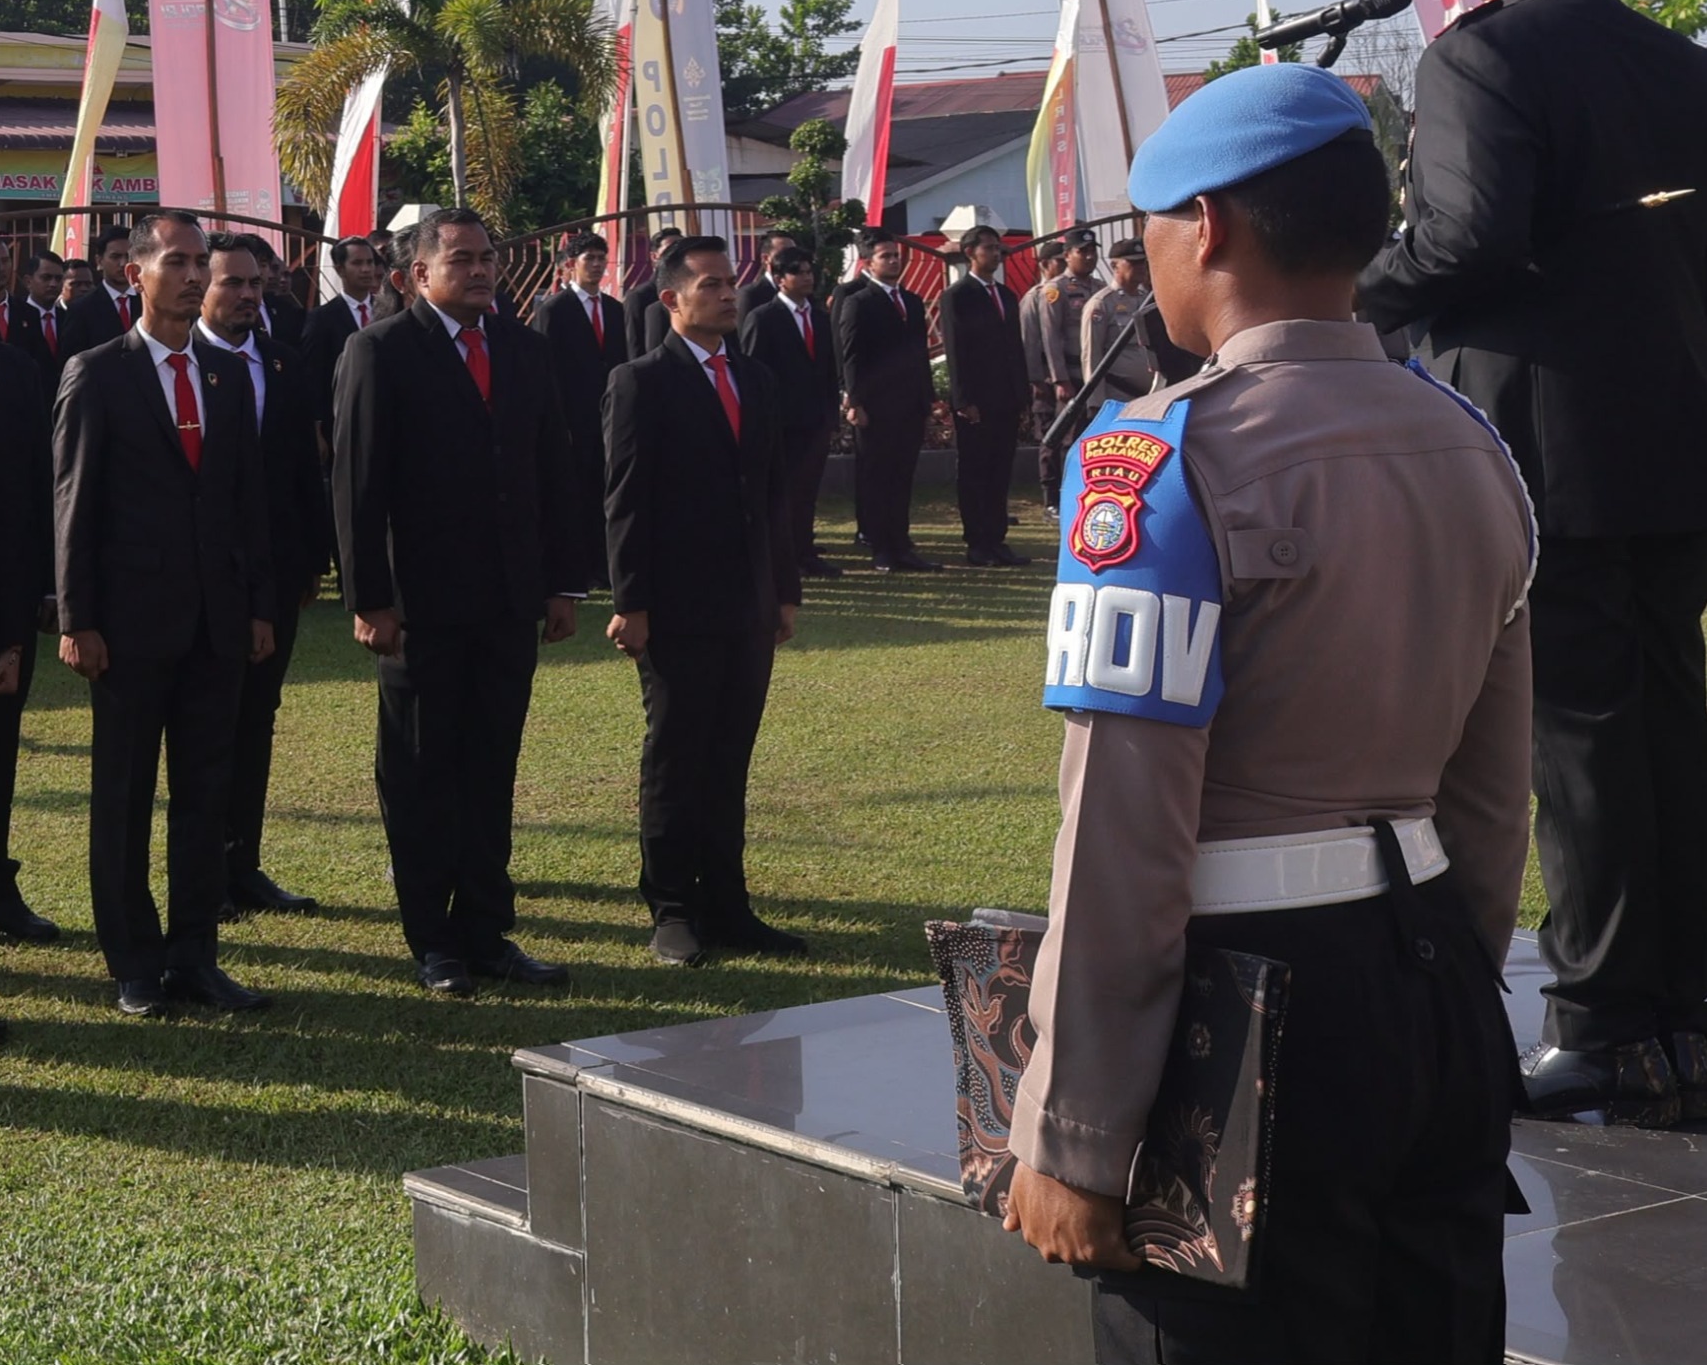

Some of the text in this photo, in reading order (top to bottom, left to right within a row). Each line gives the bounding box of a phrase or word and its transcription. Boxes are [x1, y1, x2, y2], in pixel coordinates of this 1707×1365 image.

[111, 178, 159, 191] AMB
[1085, 435, 1162, 458] POLRES
[1085, 447, 1155, 466] PELALAWAN
[1091, 467, 1140, 481] RIAU
